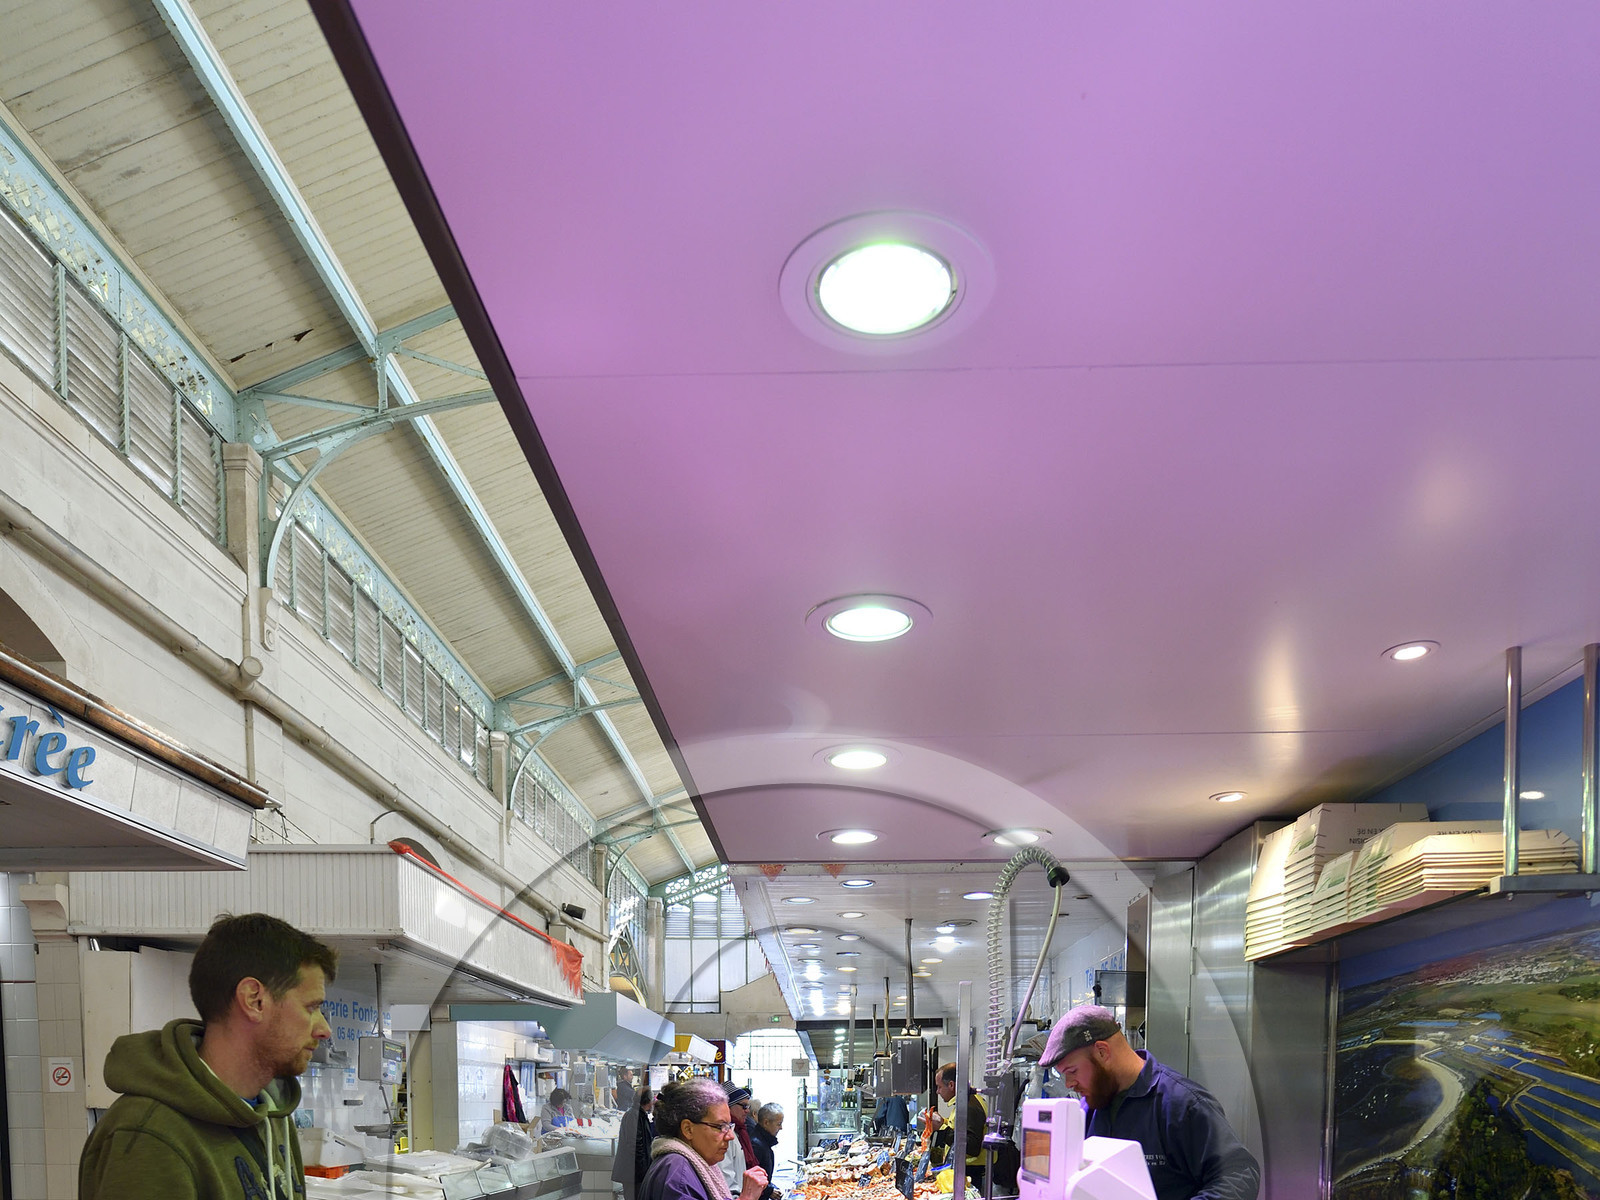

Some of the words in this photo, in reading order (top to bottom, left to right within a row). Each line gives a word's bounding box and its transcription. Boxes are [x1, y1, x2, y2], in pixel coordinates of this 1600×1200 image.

[353, 1002, 390, 1022] Fontane
[337, 1027, 345, 1040] 05
[347, 1029, 355, 1041] 46
